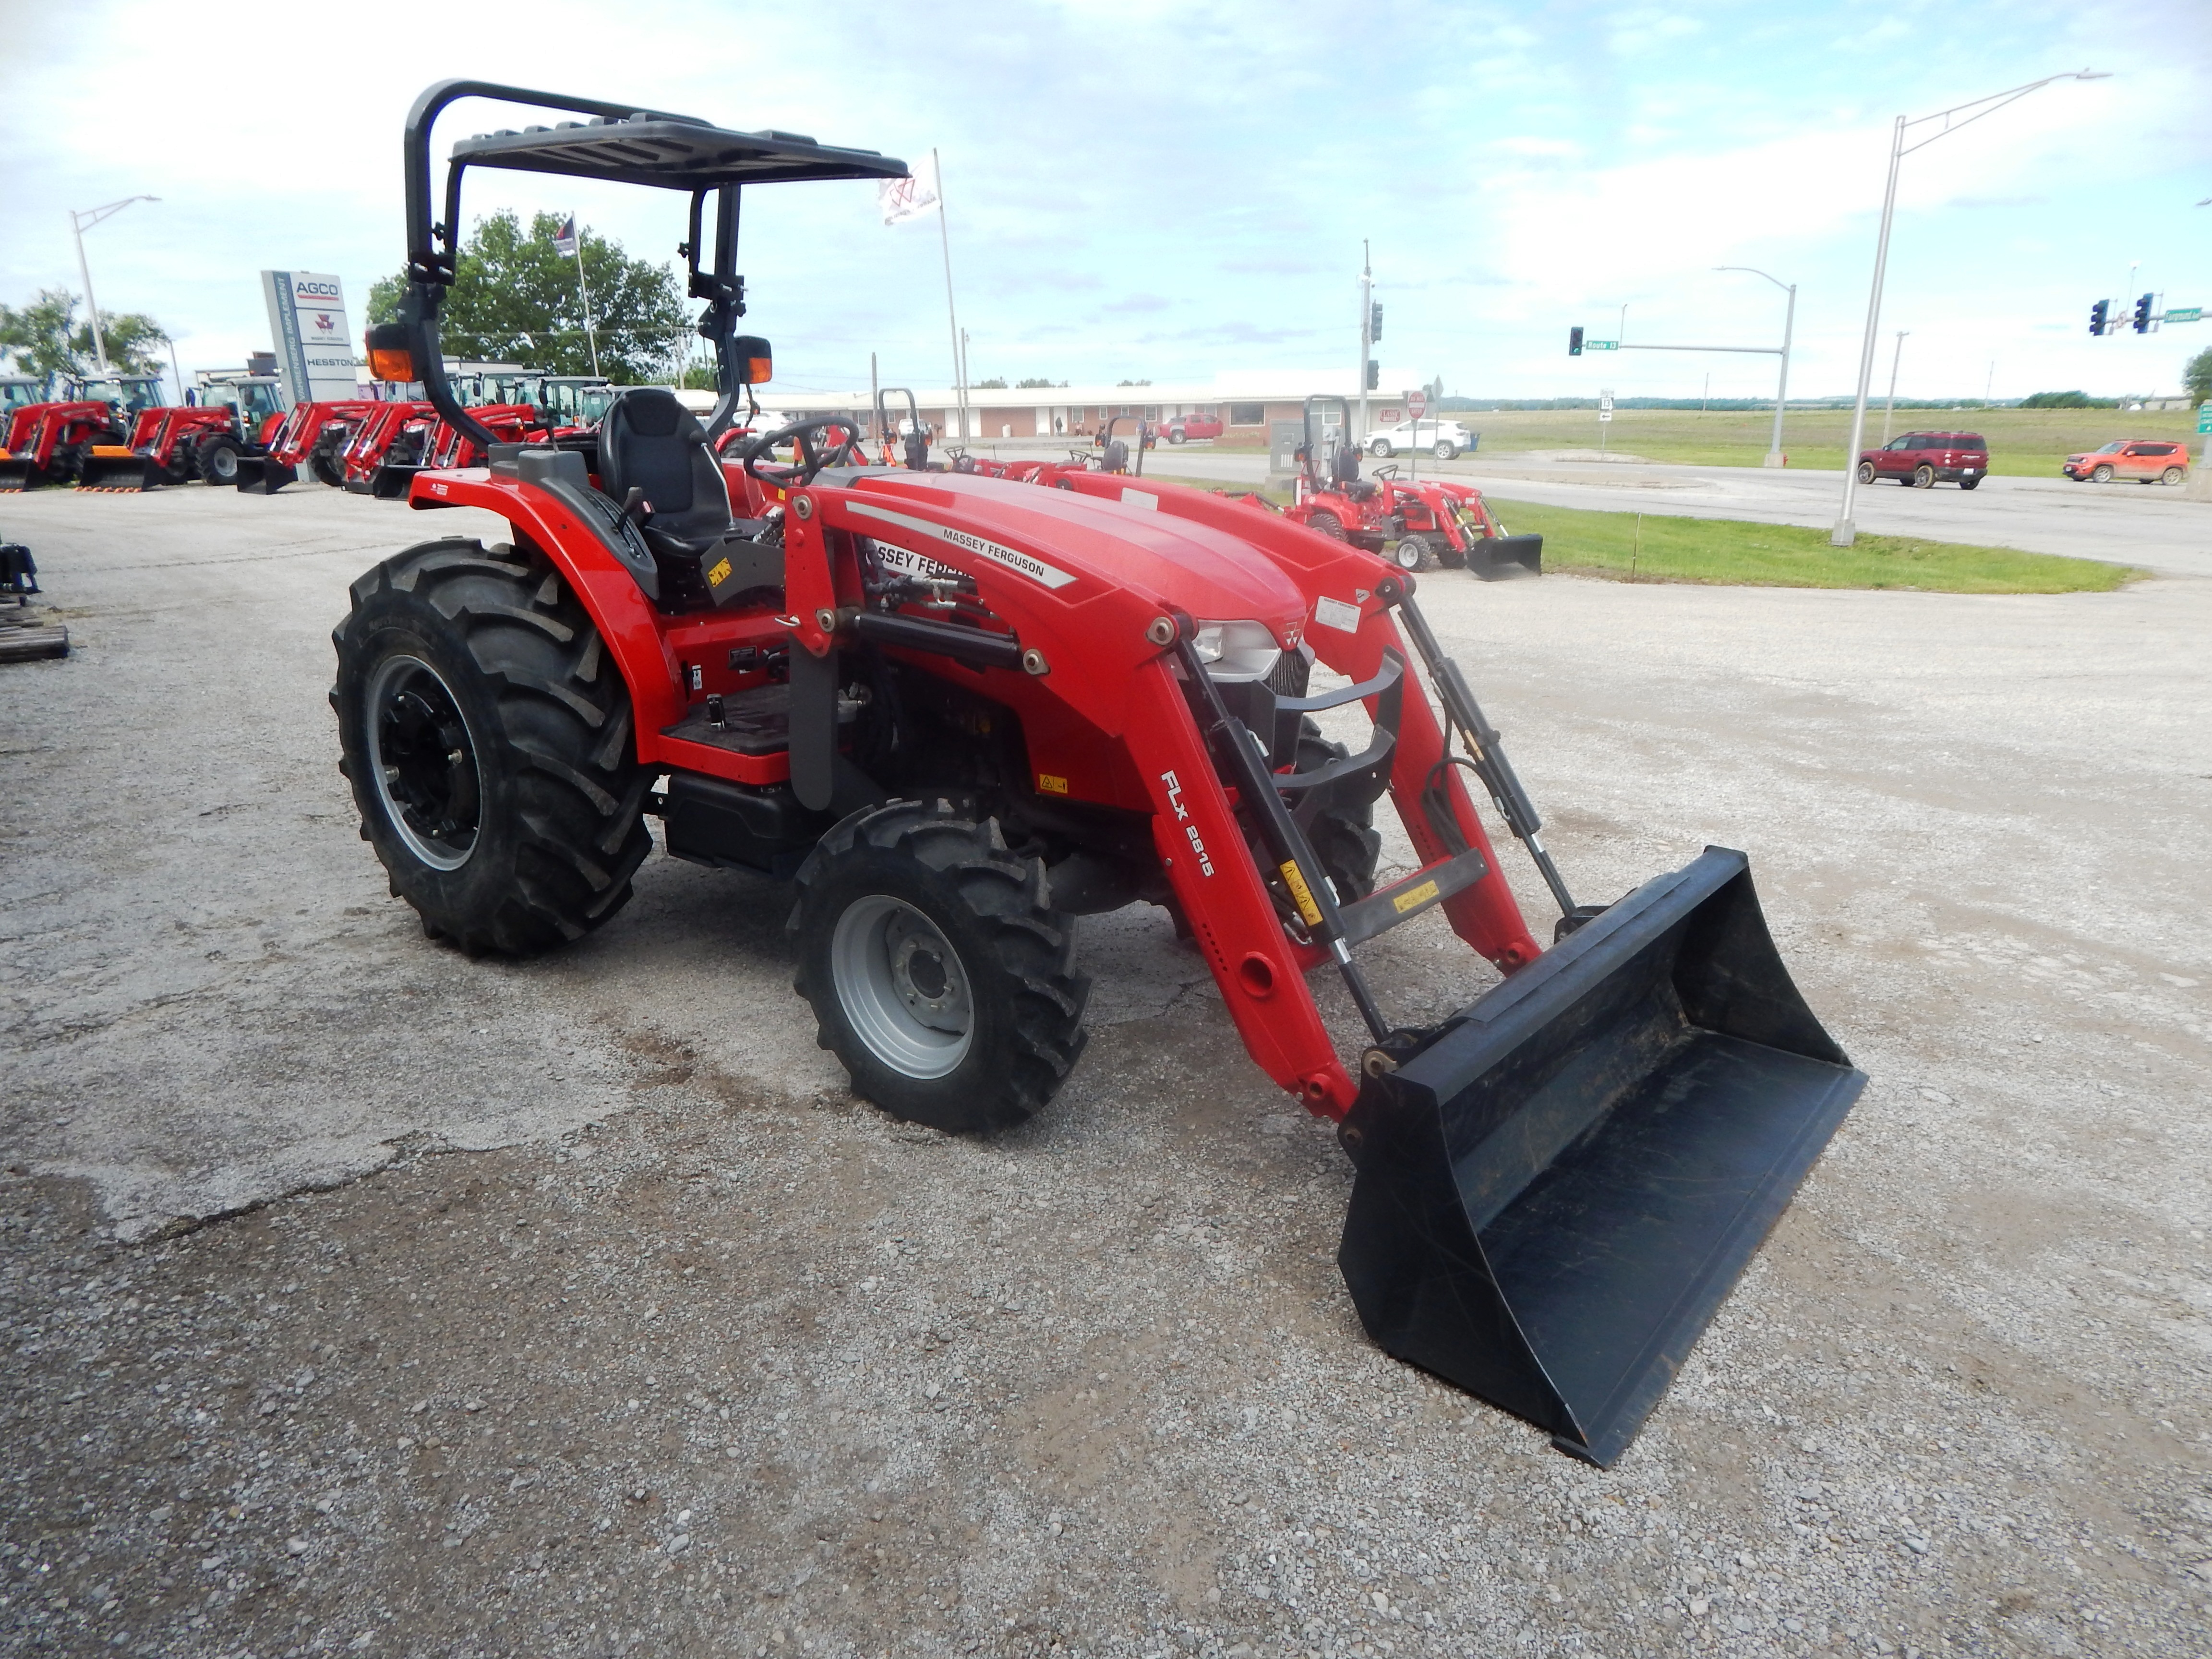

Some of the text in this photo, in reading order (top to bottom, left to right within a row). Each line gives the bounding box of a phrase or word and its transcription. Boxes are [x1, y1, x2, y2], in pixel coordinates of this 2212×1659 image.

[297, 282, 338, 295] AGCO
[277, 277, 305, 401] VAHRENBERG IMPLEMENT
[307, 359, 353, 367] HESSTON
[1603, 399, 1610, 407] 13
[878, 546, 914, 568] SSEY
[943, 529, 985, 552] MASSEY
[988, 544, 1045, 577] FERGUSON
[1161, 769, 1215, 878] FLX 2815
